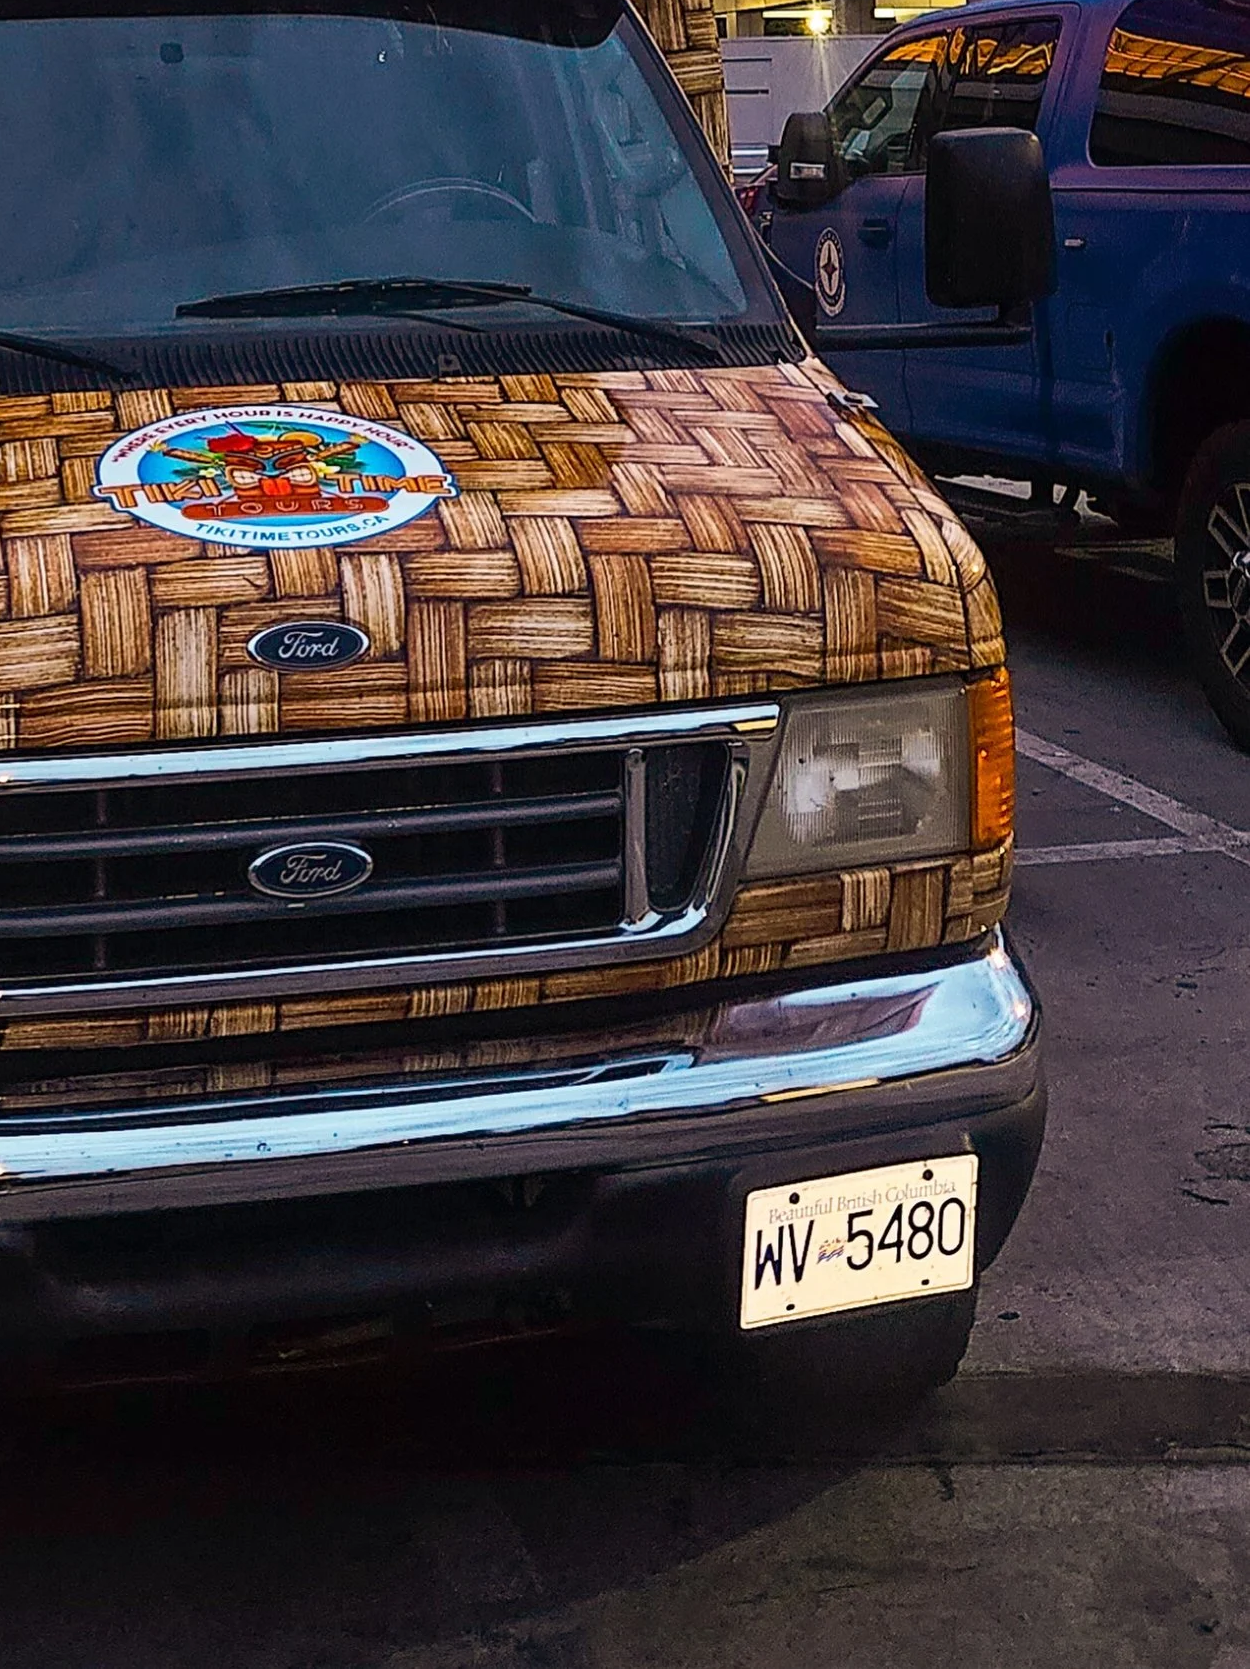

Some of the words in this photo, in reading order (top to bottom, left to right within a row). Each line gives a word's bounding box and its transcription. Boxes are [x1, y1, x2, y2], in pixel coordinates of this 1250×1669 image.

[154, 414, 208, 435] EVERY
[213, 409, 271, 420] HOUR
[276, 409, 294, 418] IS
[298, 411, 366, 428] HAPPY
[99, 476, 222, 509] TIKI
[323, 472, 453, 495] TIME
[204, 499, 366, 518] TOURS
[278, 630, 340, 660] Ford
[280, 853, 343, 884] Ford
[768, 1196, 834, 1225] Beautiful
[836, 1188, 883, 1212] British
[884, 1178, 957, 1203] Columbia
[754, 1219, 815, 1291] WV
[846, 1196, 966, 1271] 5480
